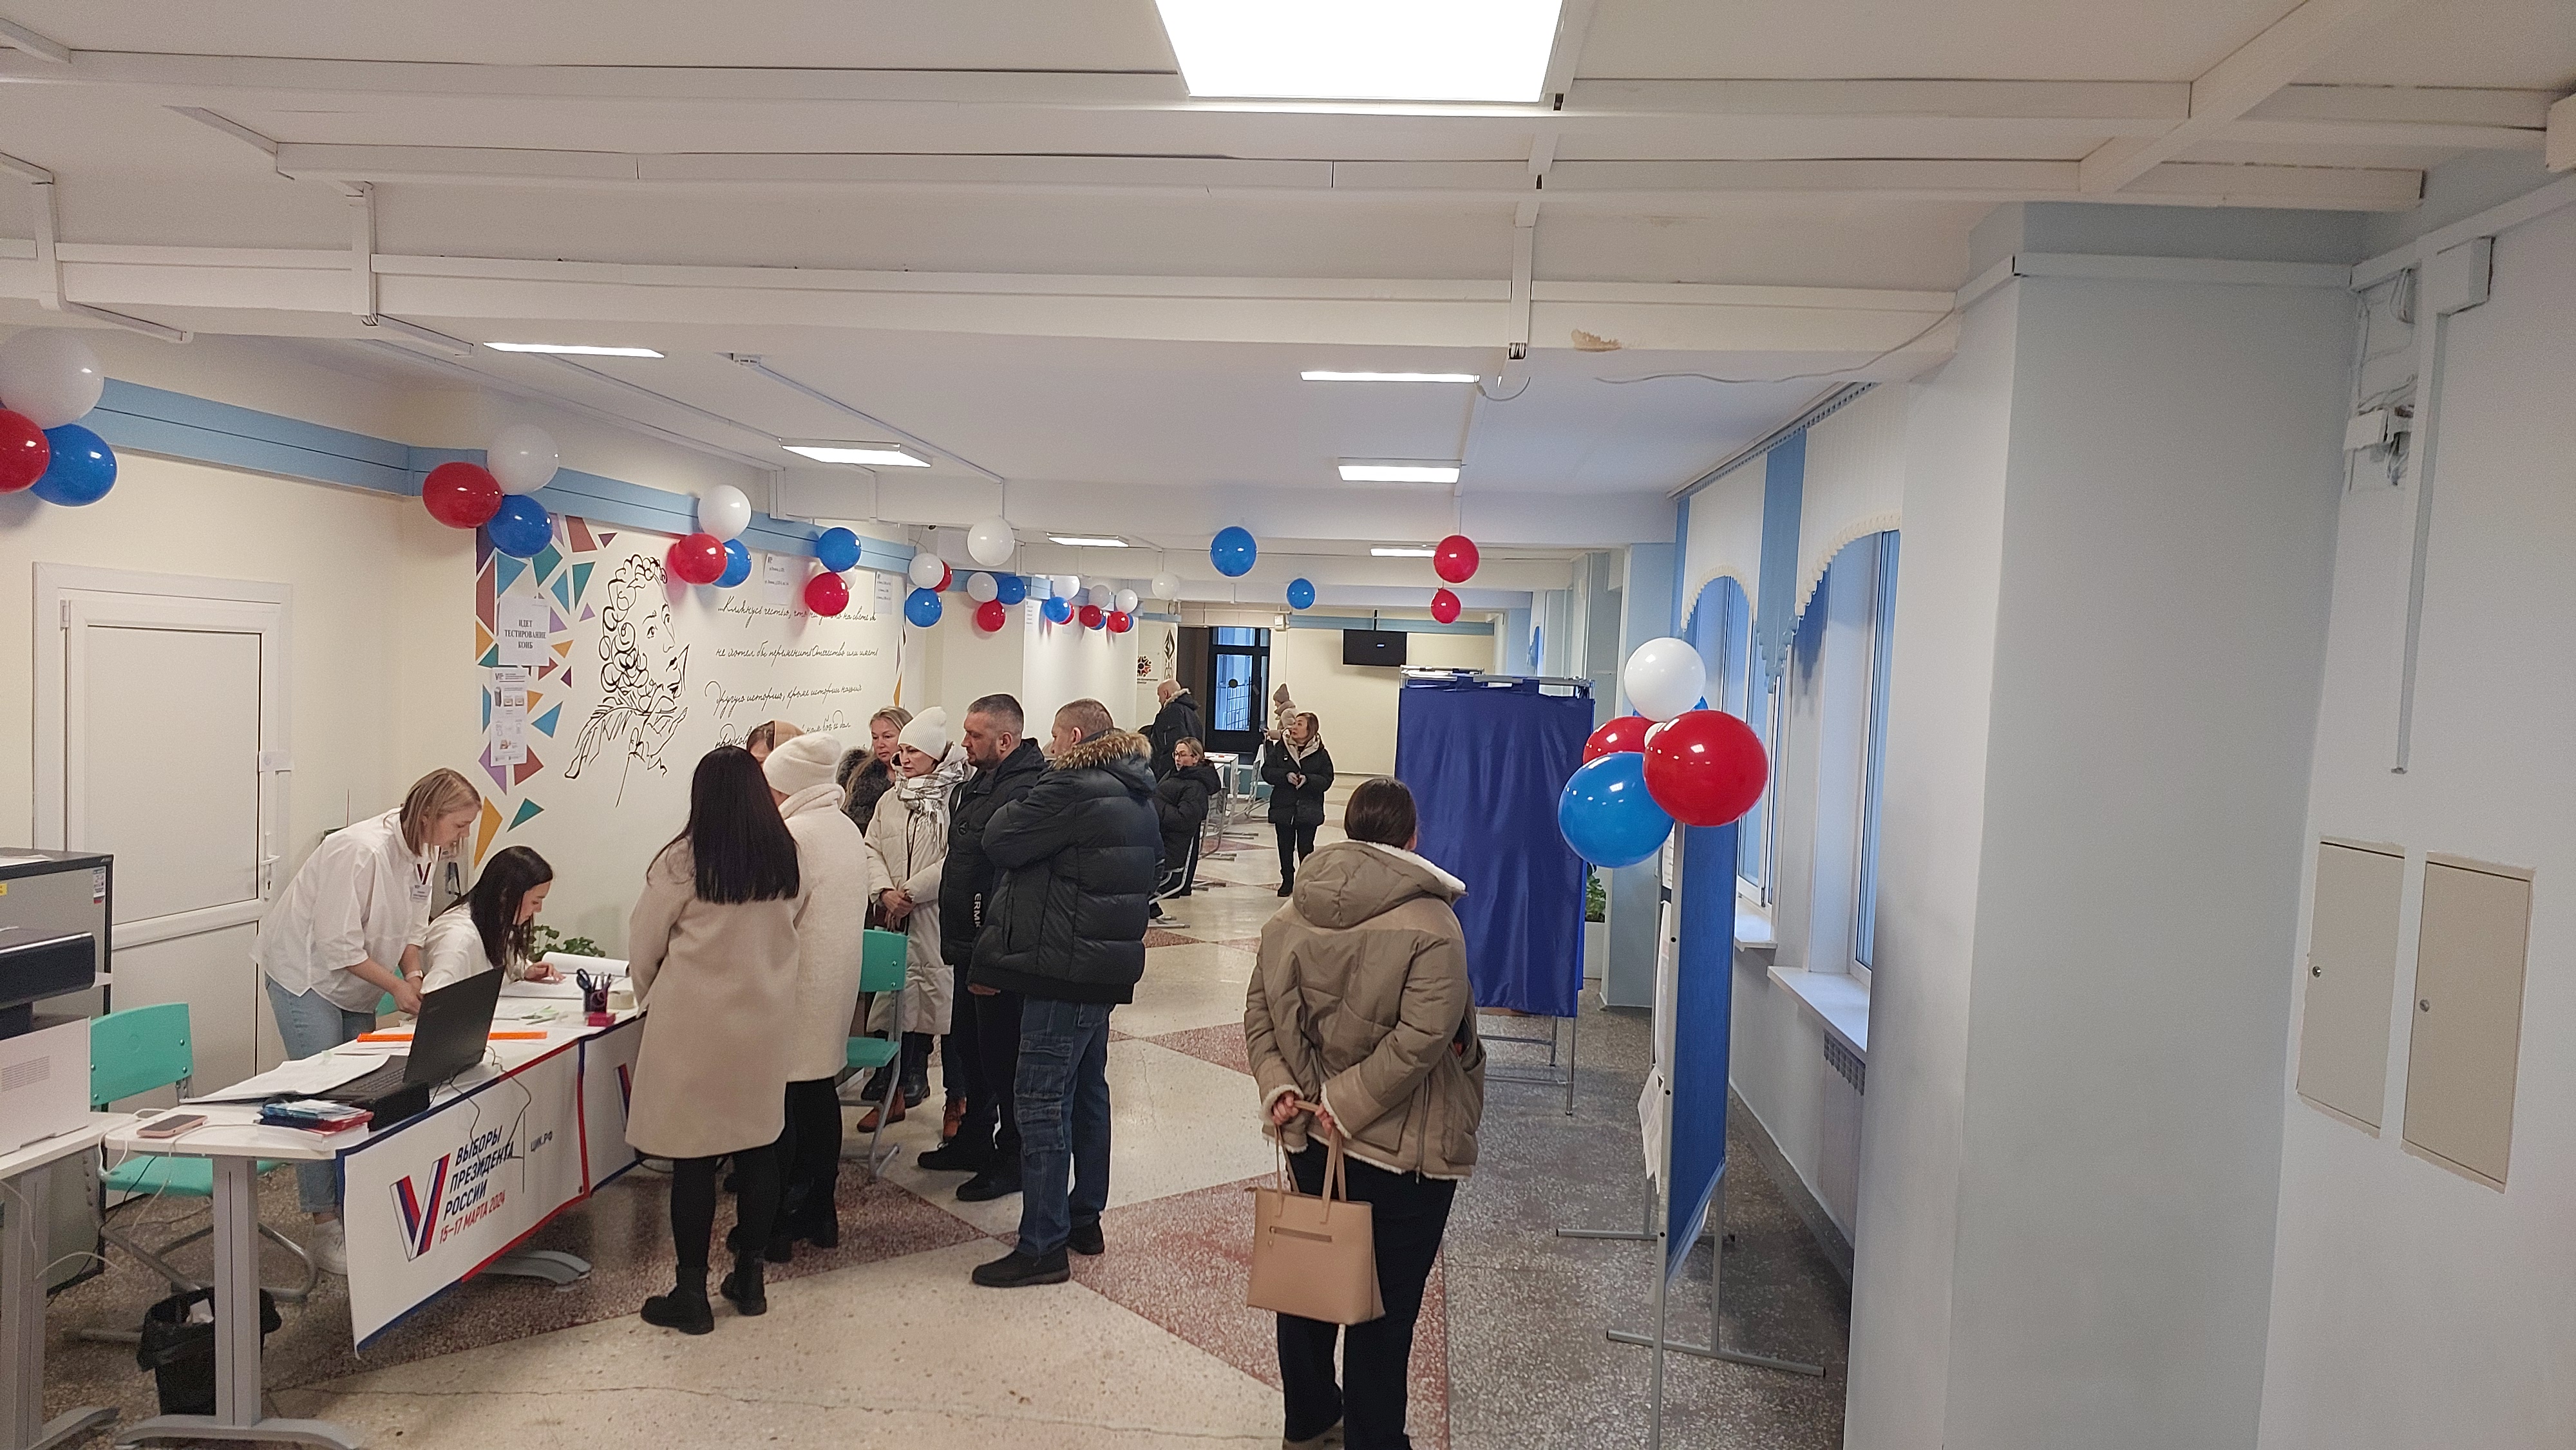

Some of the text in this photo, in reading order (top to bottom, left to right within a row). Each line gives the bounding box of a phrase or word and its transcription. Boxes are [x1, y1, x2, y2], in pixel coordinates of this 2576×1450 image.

[504, 630, 546, 639] ТЕСТИРОВАНИЕ
[518, 619, 533, 628] ИДЕТ
[455, 1125, 503, 1167] ВЫБОРЫ
[530, 1131, 553, 1152] ЦИК.РФ
[450, 1140, 514, 1194] ПРЕЗИДЕНТА
[444, 1178, 488, 1221] РОССИИ
[463, 1201, 488, 1230] МАРТА
[489, 1190, 506, 1214] 2024
